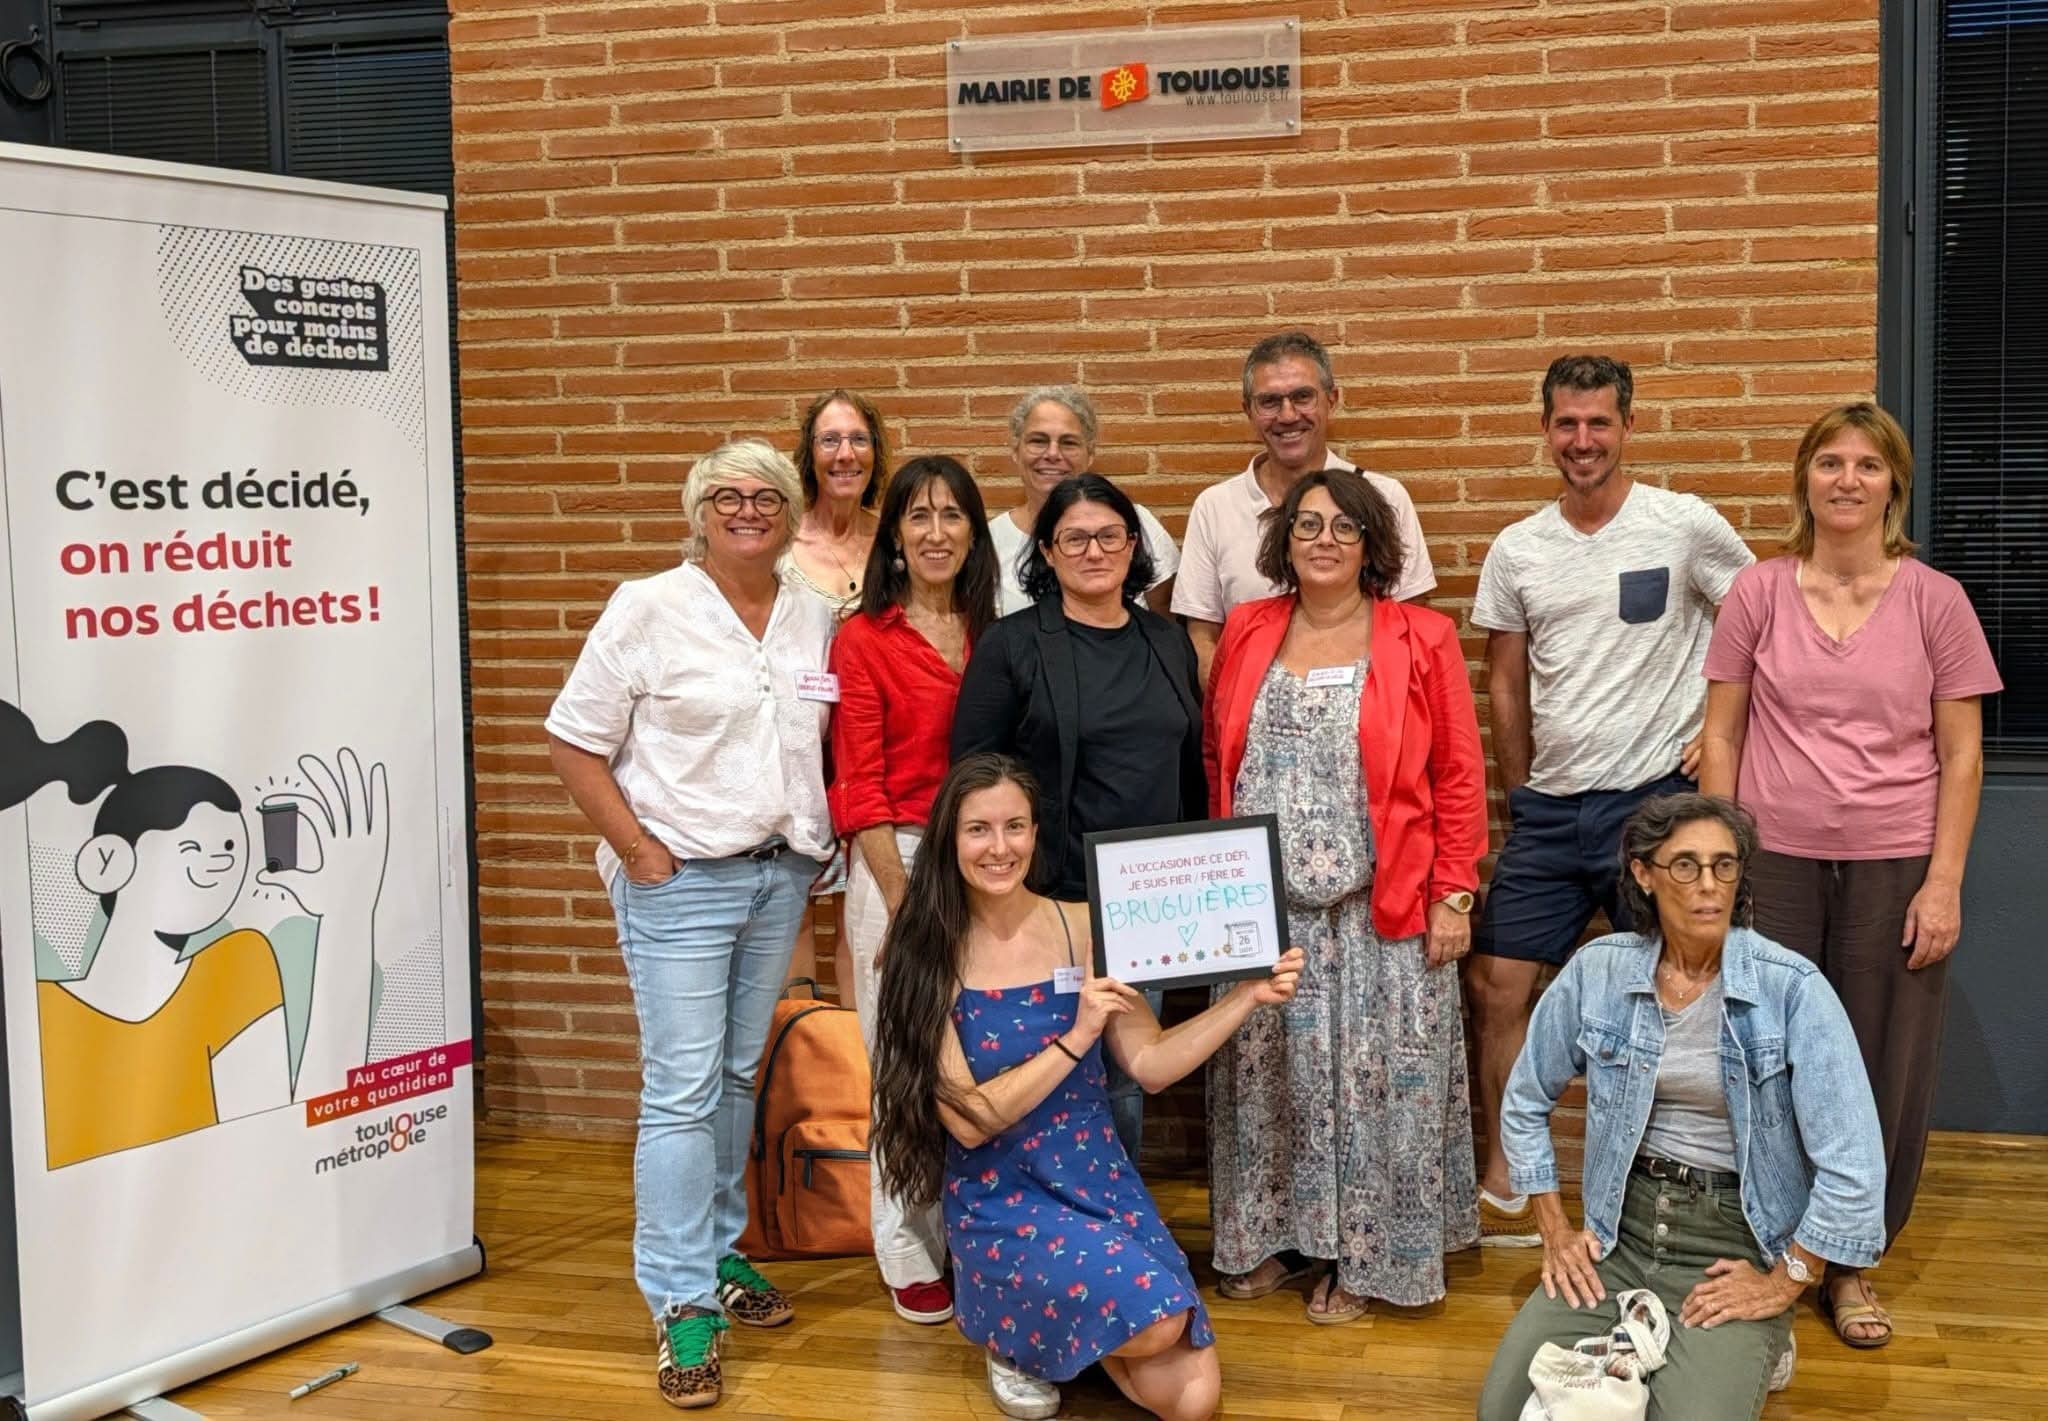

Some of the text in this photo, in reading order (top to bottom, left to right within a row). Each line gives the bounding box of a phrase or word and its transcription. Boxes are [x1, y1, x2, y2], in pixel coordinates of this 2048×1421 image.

[958, 64, 1290, 105] MAIRIE DE TOULOUSE
[1185, 88, 1290, 107] www.toulouse.fr
[243, 268, 376, 300] Des gestes
[274, 298, 377, 320] concrets
[233, 317, 377, 341] pour moins
[244, 335, 378, 361] de déchets
[56, 468, 370, 517] C'est décidé,
[60, 529, 292, 575] on réduit
[66, 602, 159, 639] nos
[1128, 880, 1141, 891] JE
[1142, 876, 1168, 889] SUIS
[1170, 874, 1192, 886] FIER
[1201, 868, 1230, 881] FIÈRE
[1231, 867, 1246, 878] DE
[1129, 857, 1192, 874] L'OCCASION
[1194, 855, 1207, 866] DE
[1209, 853, 1223, 864] CE
[1239, 935, 1250, 946] 26
[353, 1053, 446, 1087] Au cœur de
[313, 1072, 447, 1117] votre quotidien
[355, 1104, 448, 1142] toulouse
[315, 1128, 426, 1175] métropole
